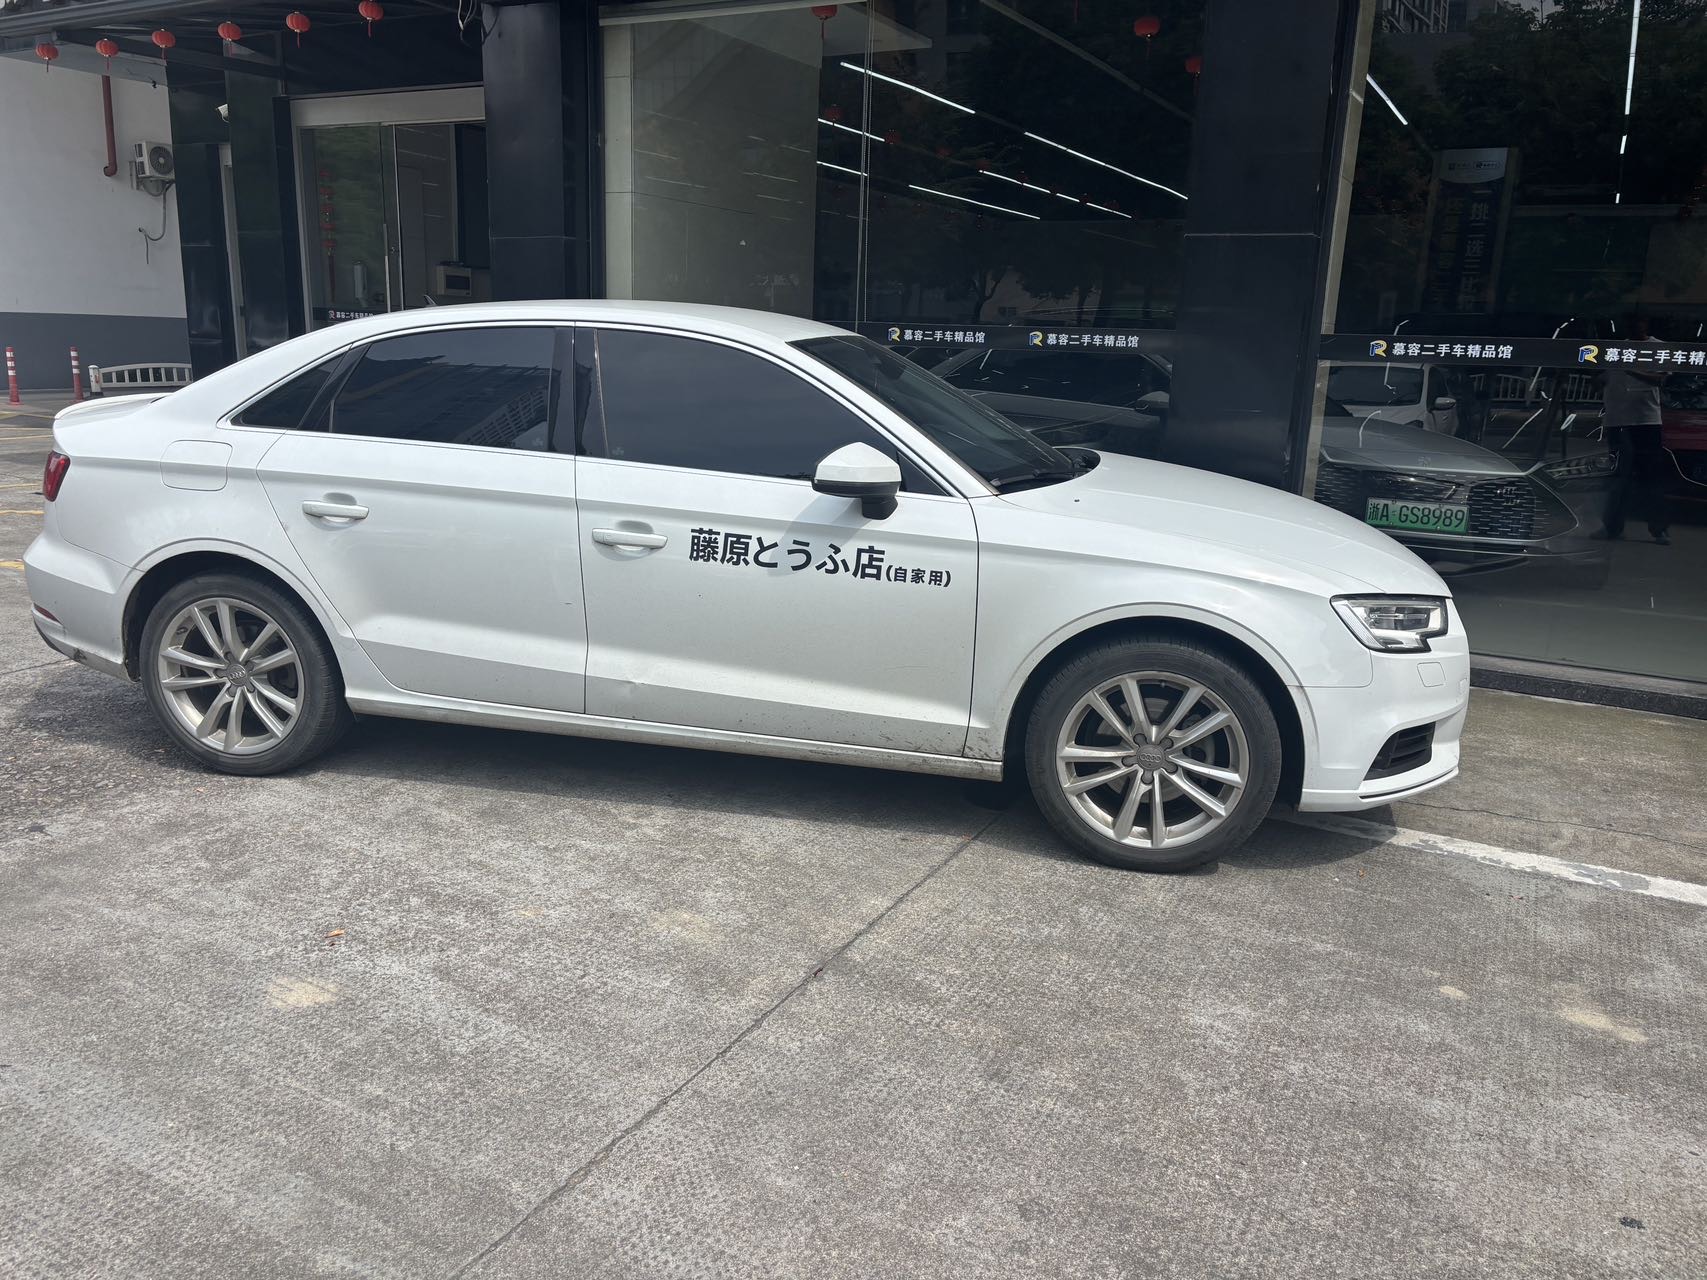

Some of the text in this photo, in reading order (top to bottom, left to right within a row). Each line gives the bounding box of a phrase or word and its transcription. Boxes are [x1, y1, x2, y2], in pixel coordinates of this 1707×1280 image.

[903, 329, 986, 343] 慕容二手车精品馆
[1046, 333, 1139, 348] 慕容二手车精品馆
[1391, 342, 1513, 359] 慕容二手车精品馆
[1604, 348, 1707, 366] 慕容二手车精
